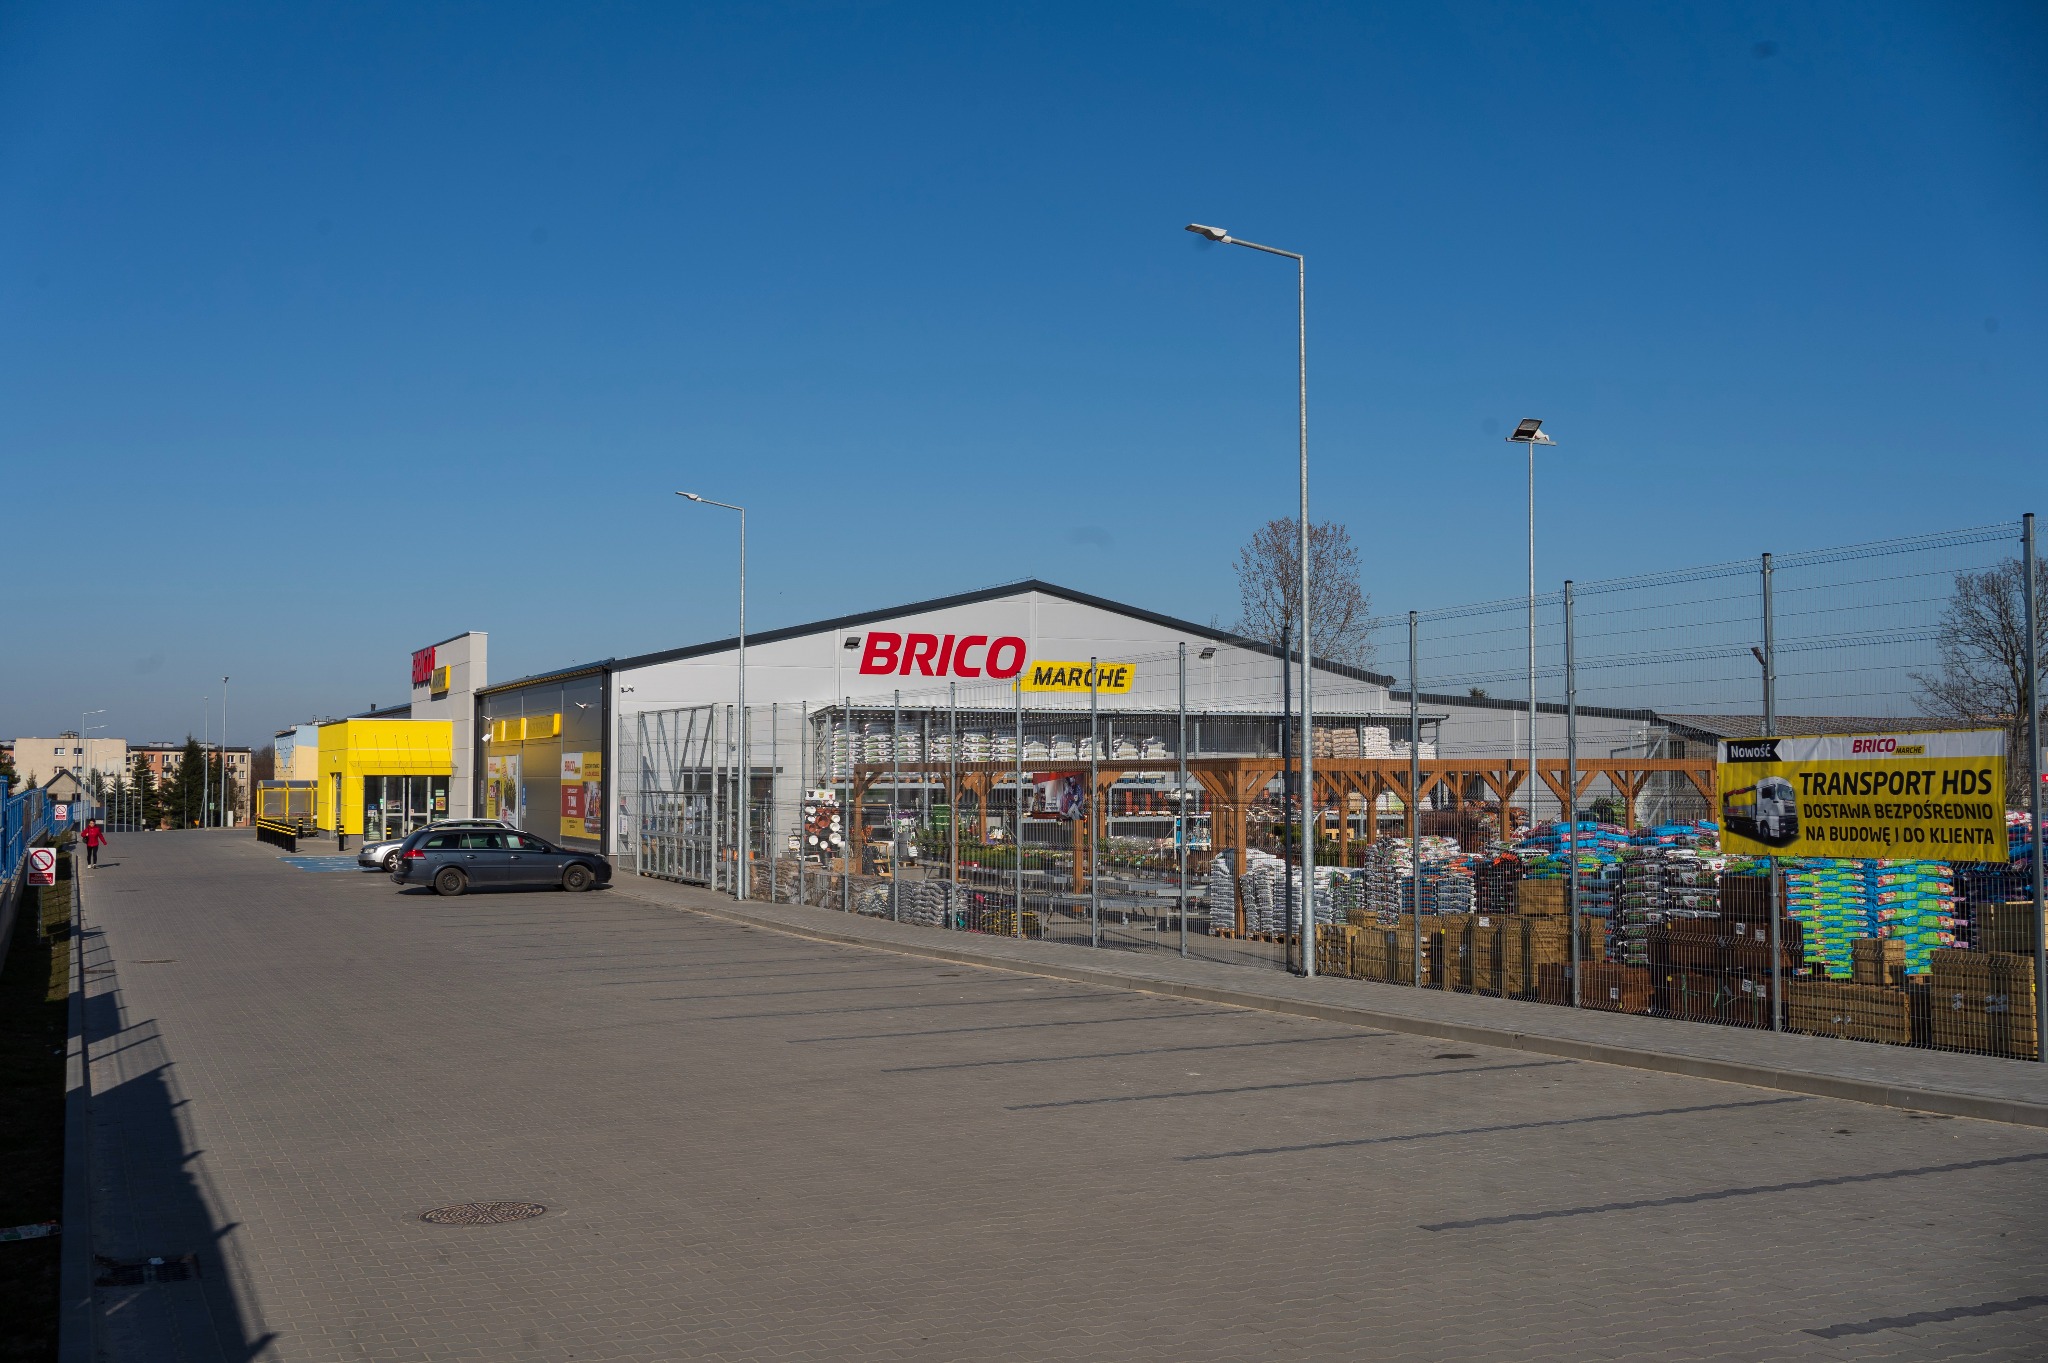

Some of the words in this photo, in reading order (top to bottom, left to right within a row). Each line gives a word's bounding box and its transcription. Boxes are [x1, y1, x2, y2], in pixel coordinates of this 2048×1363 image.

[859, 632, 1026, 679] BRICO
[1033, 667, 1128, 688] MARCHÉ
[1731, 743, 1771, 758] Nowość
[1852, 738, 1897, 753] BRICO
[1895, 746, 1922, 754] MARCHÉ
[1799, 770, 1936, 796] TRANSPORT
[1942, 769, 1992, 795] HDS
[1803, 804, 1871, 818] DOSTAWA
[1874, 800, 1993, 819] BEZPOŚREDNIO
[1806, 826, 1825, 841] NA
[1830, 826, 1891, 846] BUDOWĘ
[1895, 827, 1899, 842] I
[1903, 827, 1925, 842] DO
[1930, 827, 1994, 844] KLIENTA
